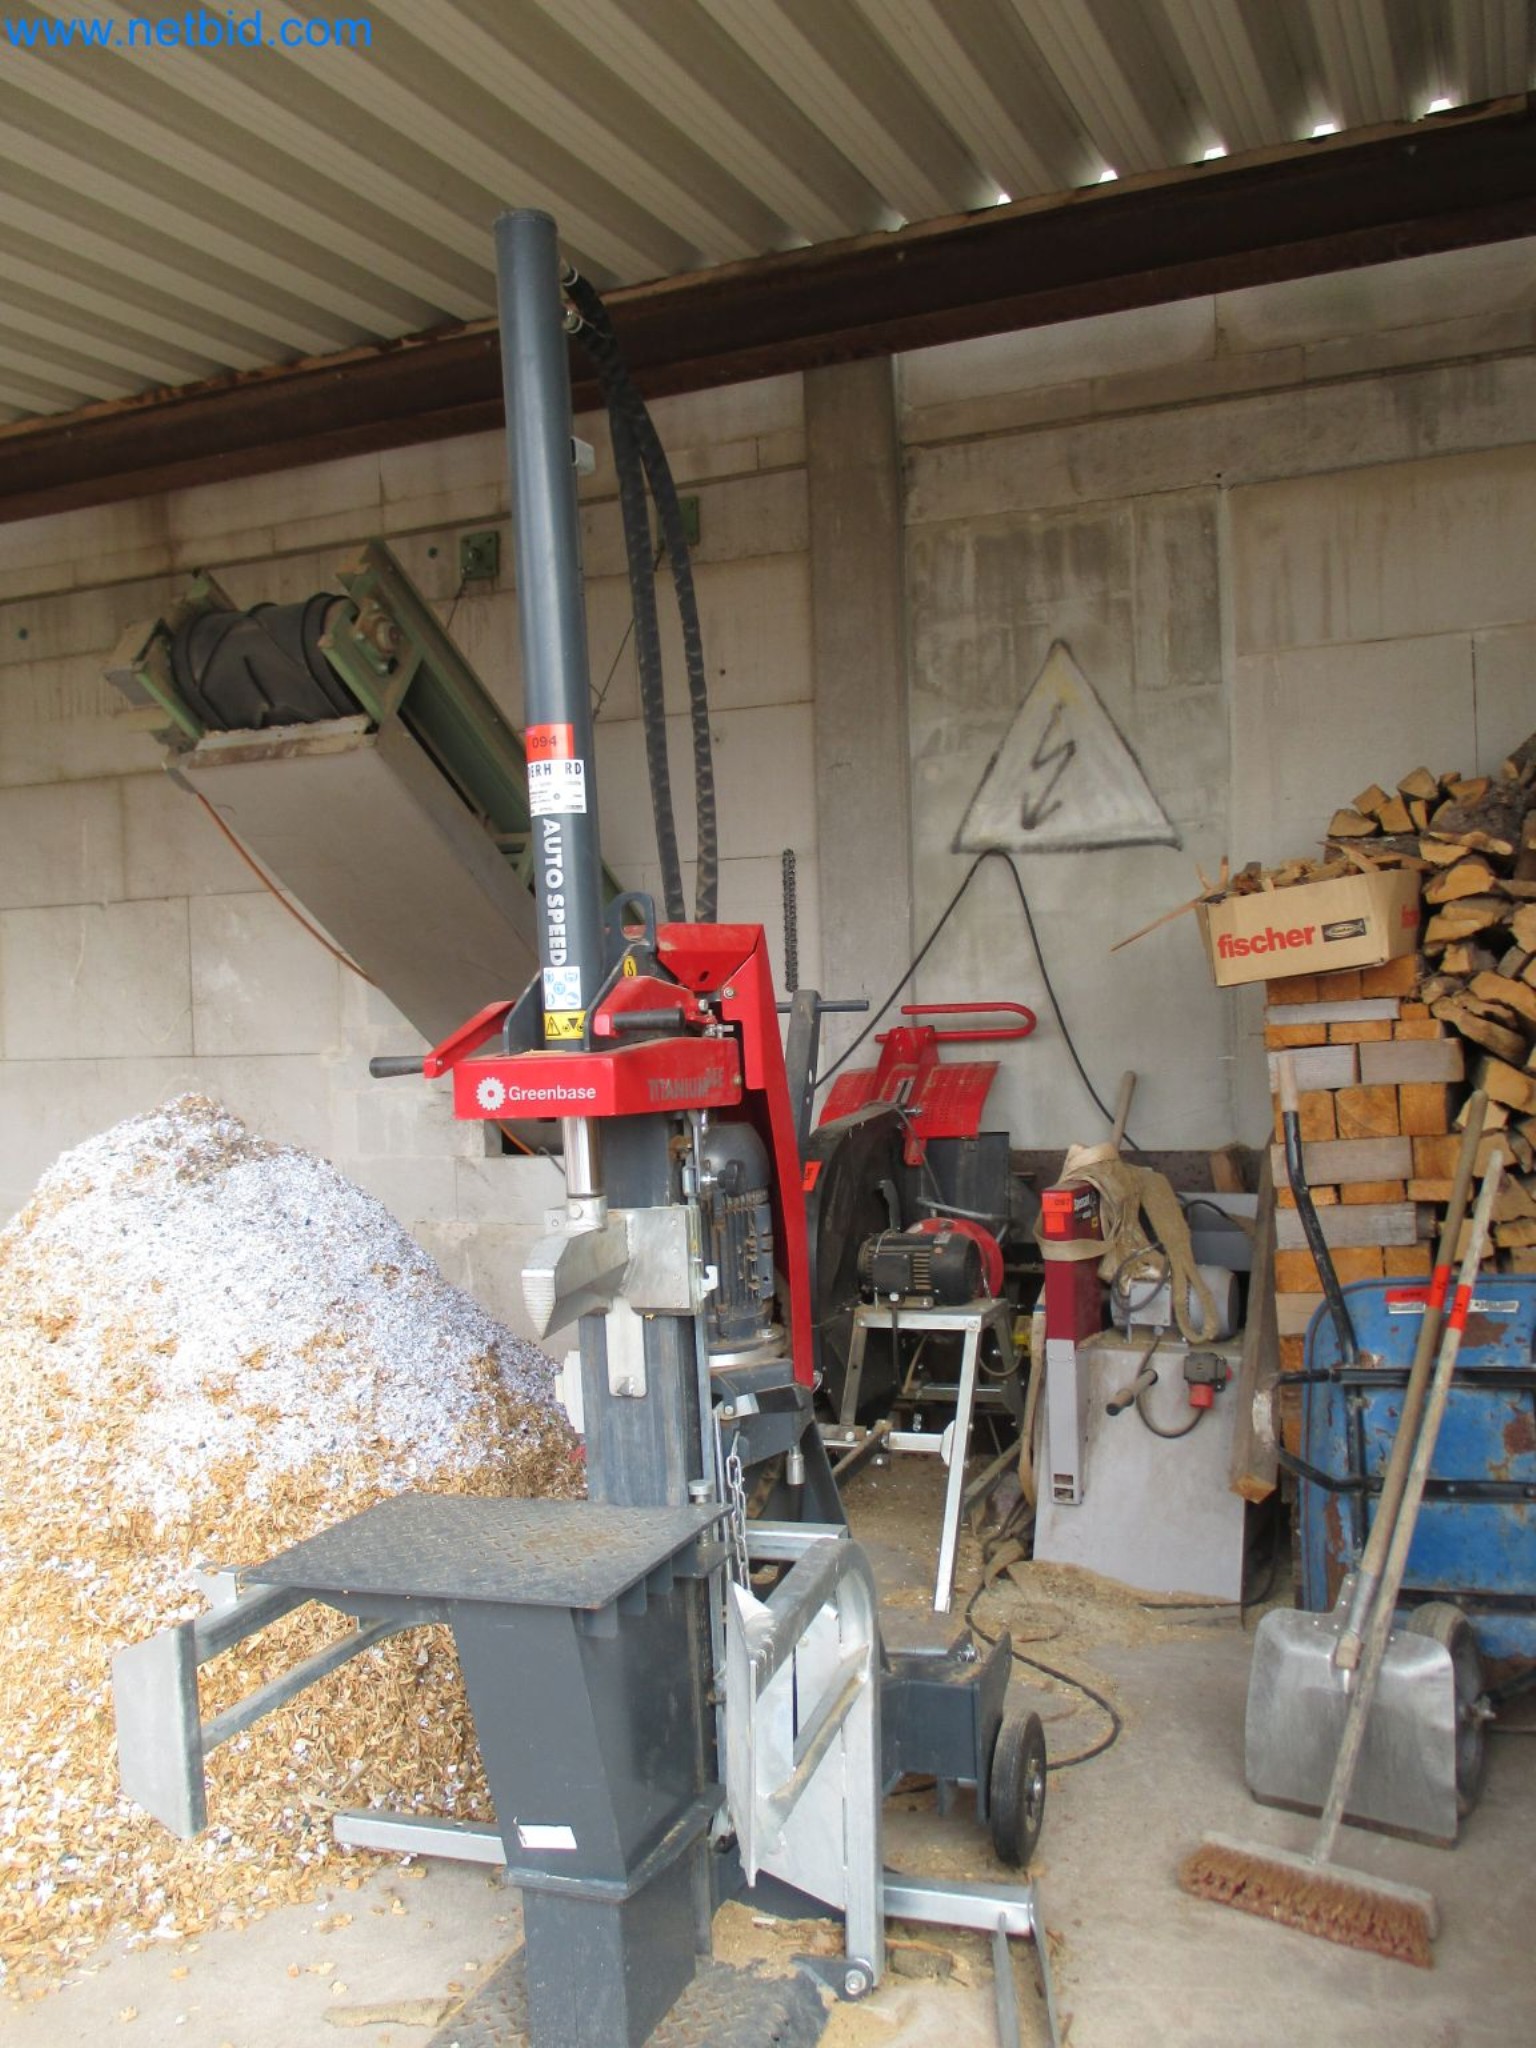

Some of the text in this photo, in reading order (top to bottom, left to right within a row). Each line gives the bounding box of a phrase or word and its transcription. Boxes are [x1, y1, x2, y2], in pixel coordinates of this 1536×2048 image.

[532, 735, 557, 749] 094
[543, 819, 567, 967] AUTO SPEED
[1217, 926, 1316, 960] fischer
[508, 1085, 597, 1102] Greenbase
